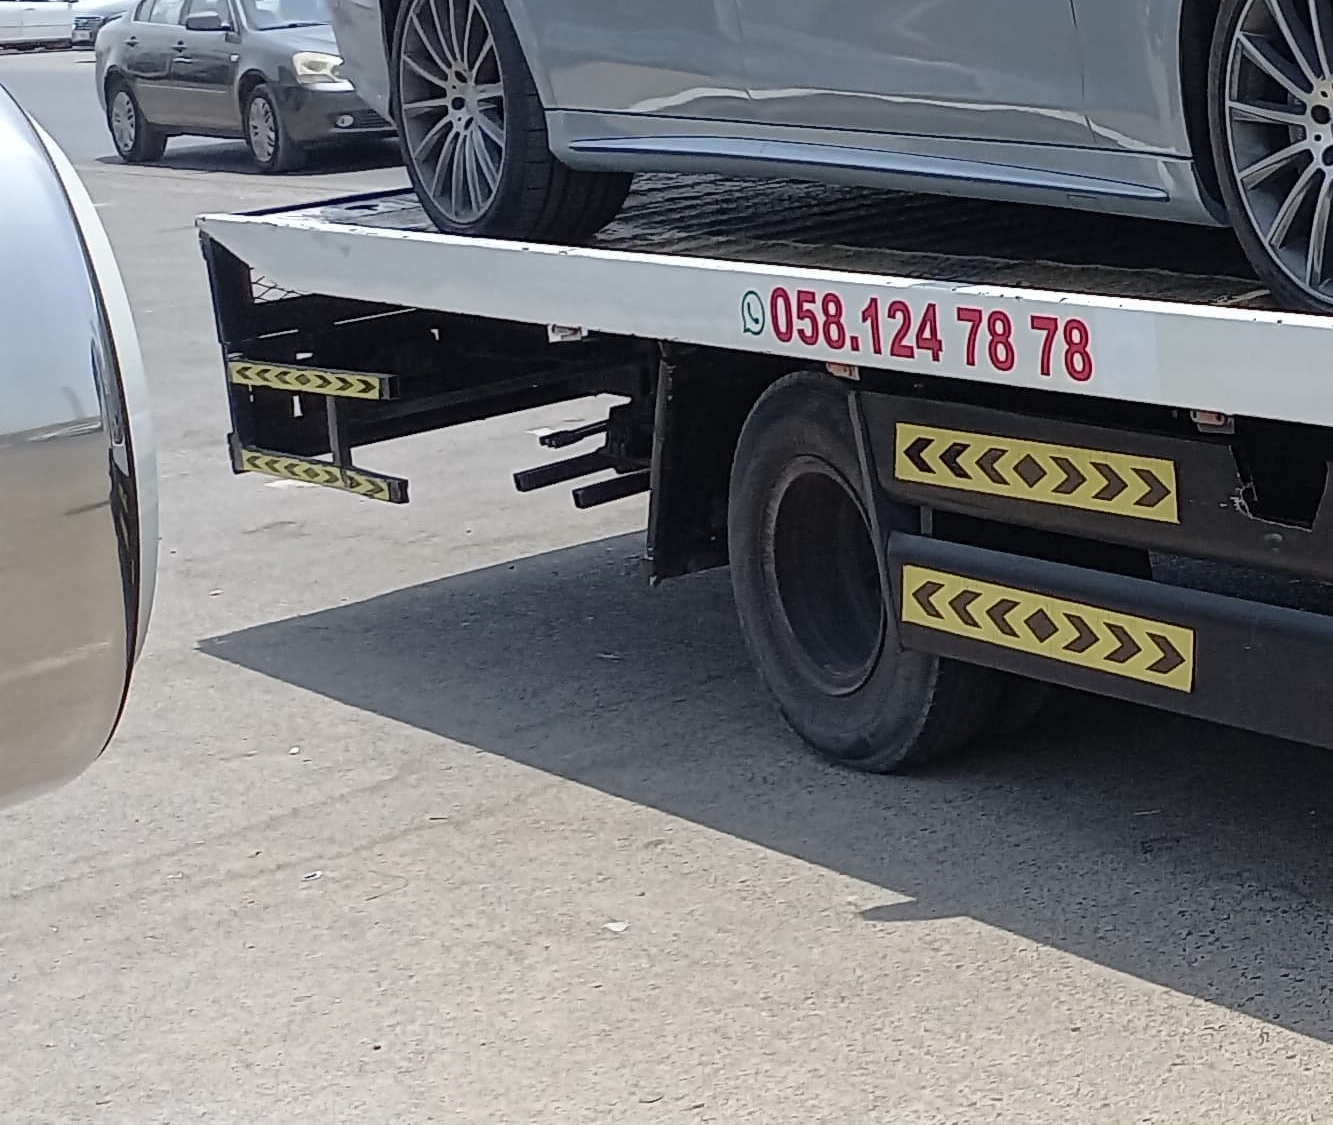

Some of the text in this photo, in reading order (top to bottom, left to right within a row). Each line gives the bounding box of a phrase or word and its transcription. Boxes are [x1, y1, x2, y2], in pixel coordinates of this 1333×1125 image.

[769, 286, 1094, 382] 058.124 78 78
